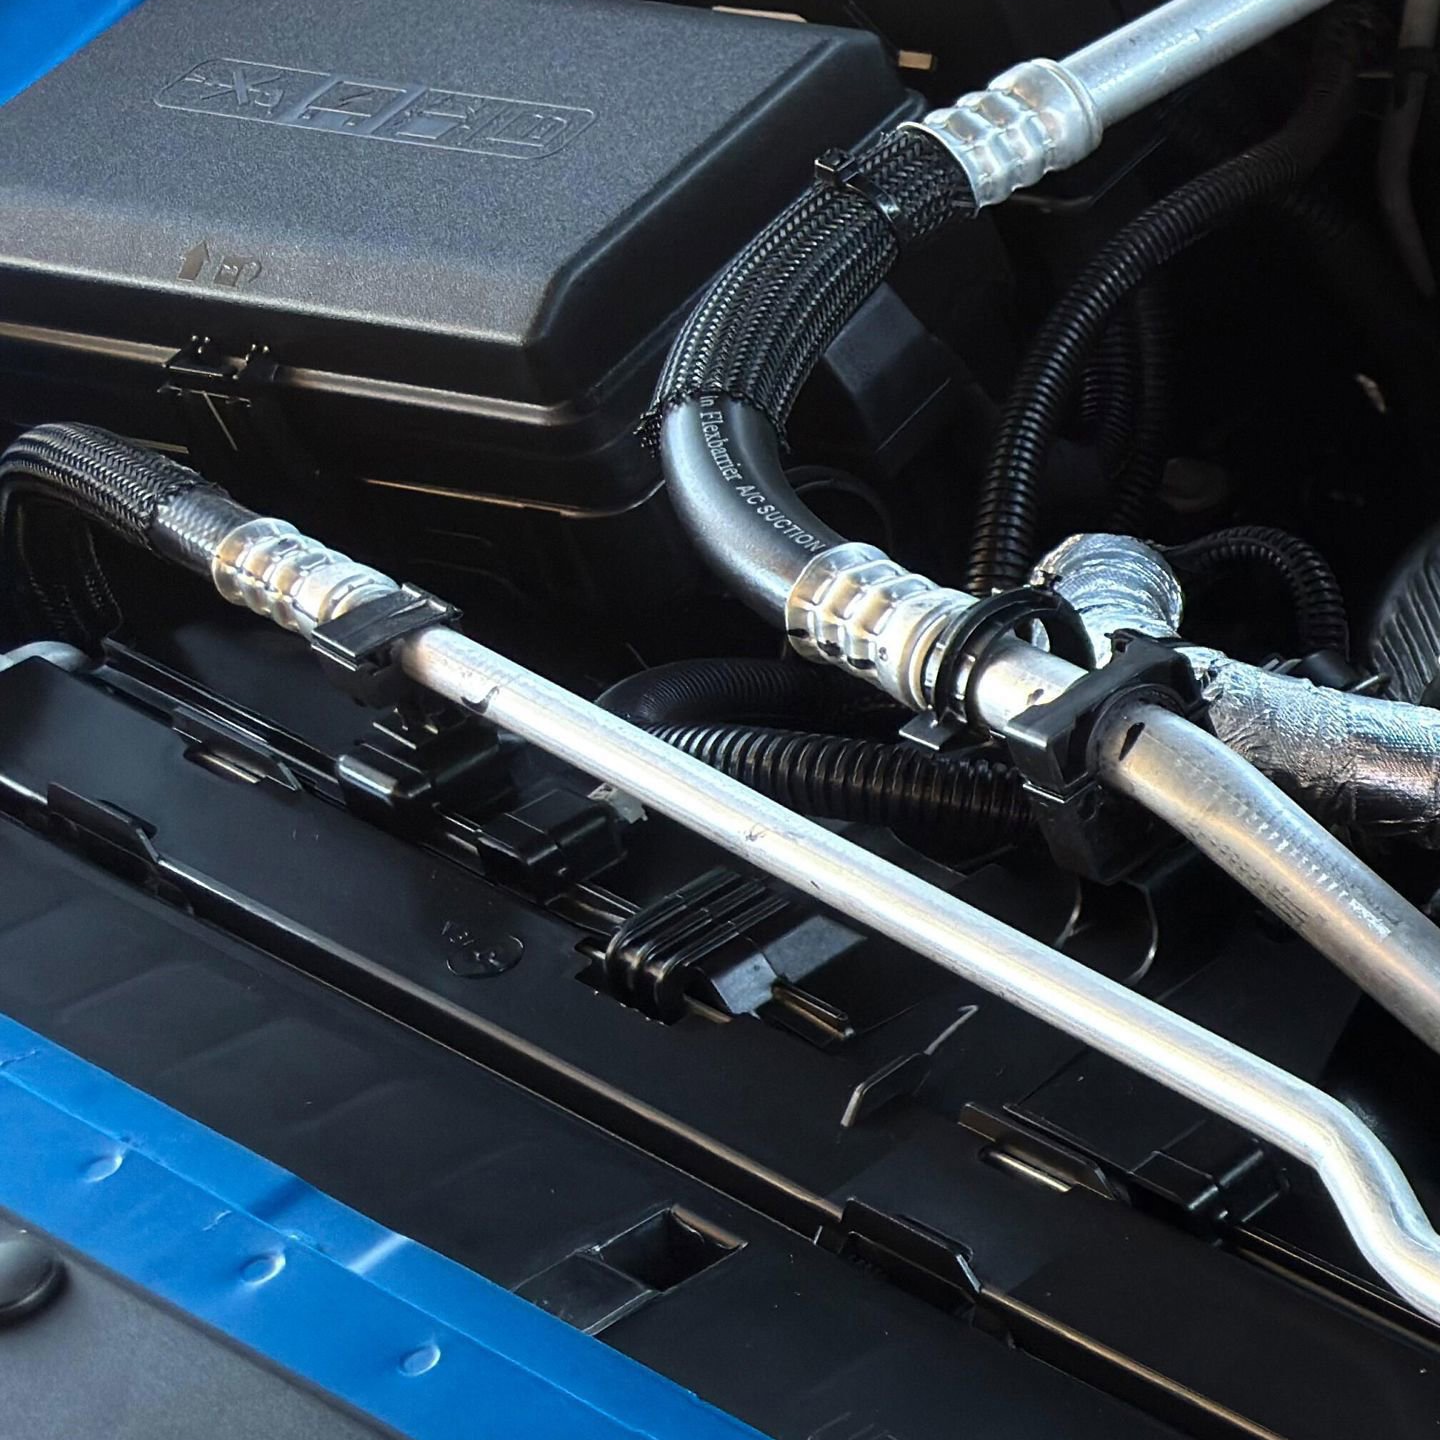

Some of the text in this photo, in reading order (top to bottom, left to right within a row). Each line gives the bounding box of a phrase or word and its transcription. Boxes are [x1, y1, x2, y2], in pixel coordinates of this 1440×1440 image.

[700, 411, 743, 482] Flexbarrier
[736, 484, 765, 505] A/C
[757, 504, 827, 552] SUCTION
